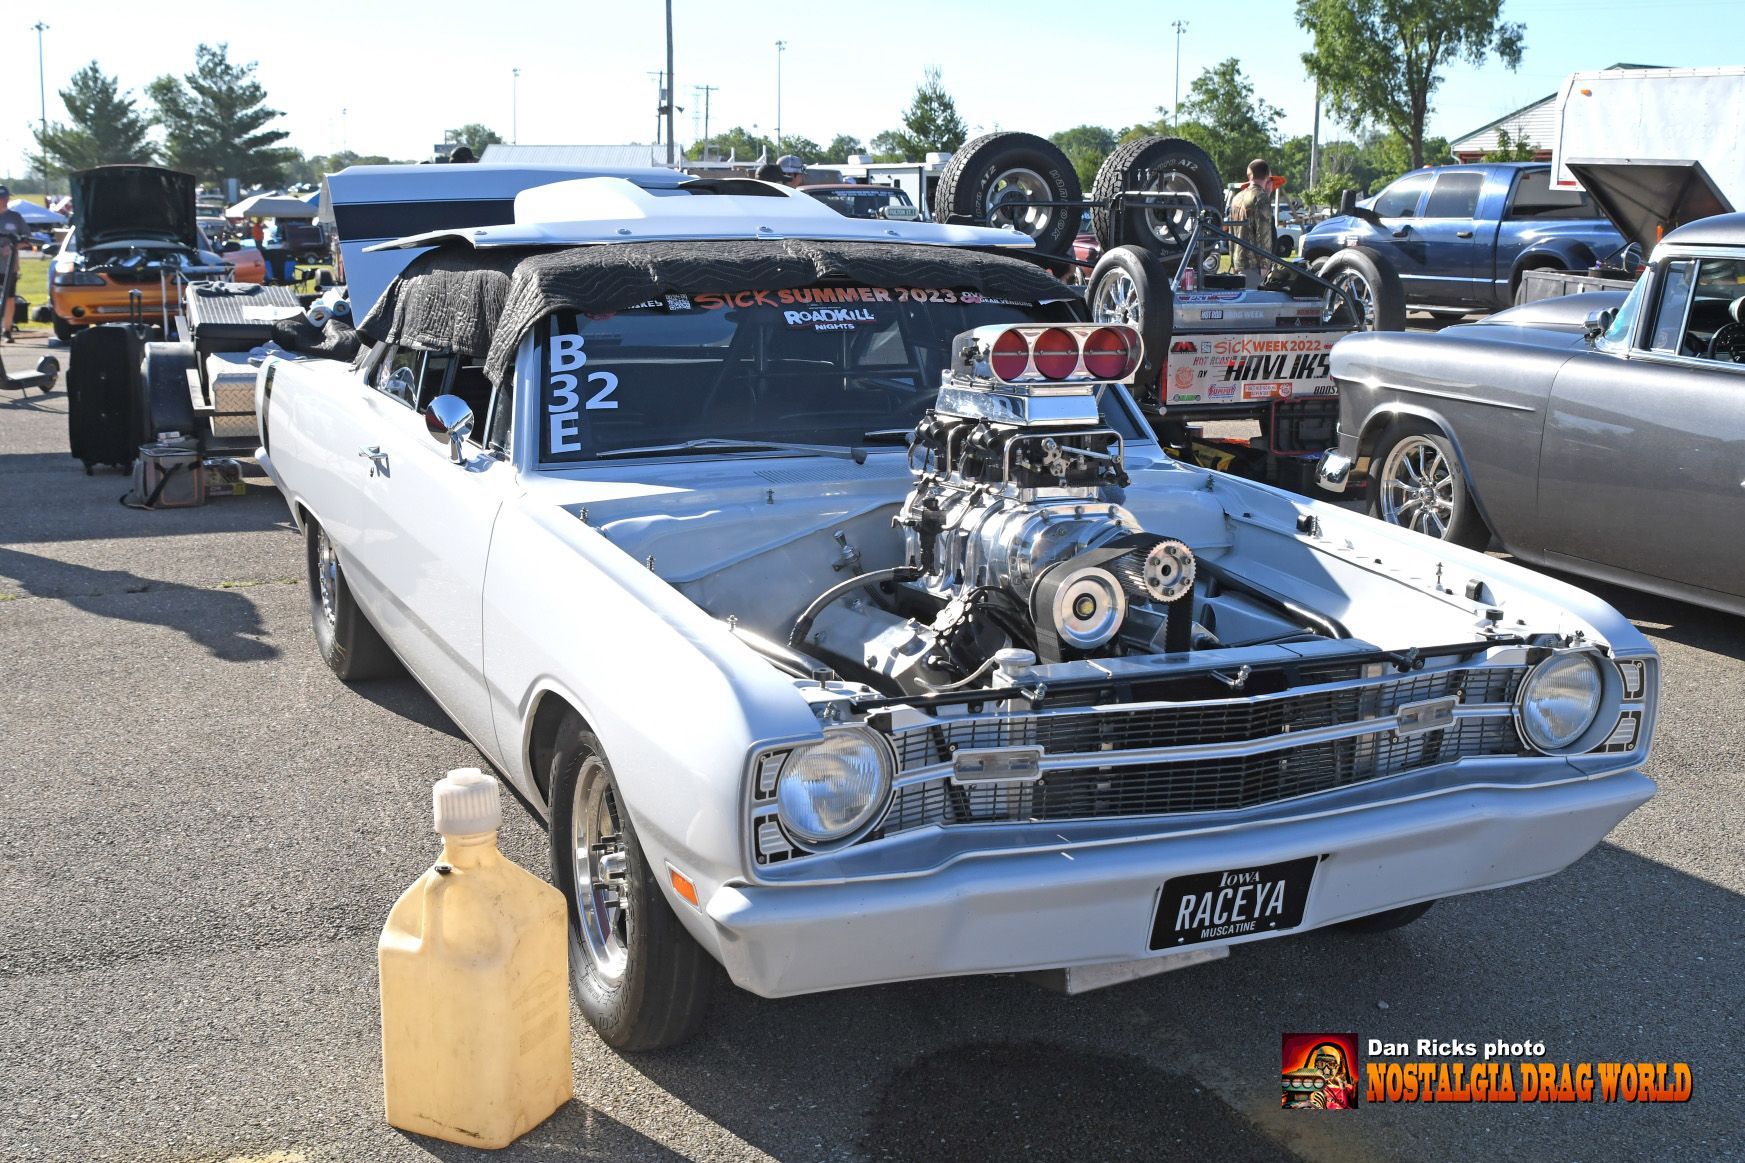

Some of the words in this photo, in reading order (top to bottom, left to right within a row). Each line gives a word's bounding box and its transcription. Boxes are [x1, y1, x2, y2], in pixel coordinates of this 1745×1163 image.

[694, 289, 779, 310] SICK
[777, 287, 892, 304] SUMMER
[784, 308, 875, 325] ROADKILL
[815, 323, 855, 331] NIGHTS
[549, 334, 587, 373] B
[1252, 341, 1289, 353] WEEK
[1289, 341, 1321, 352] 2022
[549, 411, 582, 454] E
[1175, 879, 1286, 932] RACEYA
[1200, 921, 1257, 939] MUSCATINE
